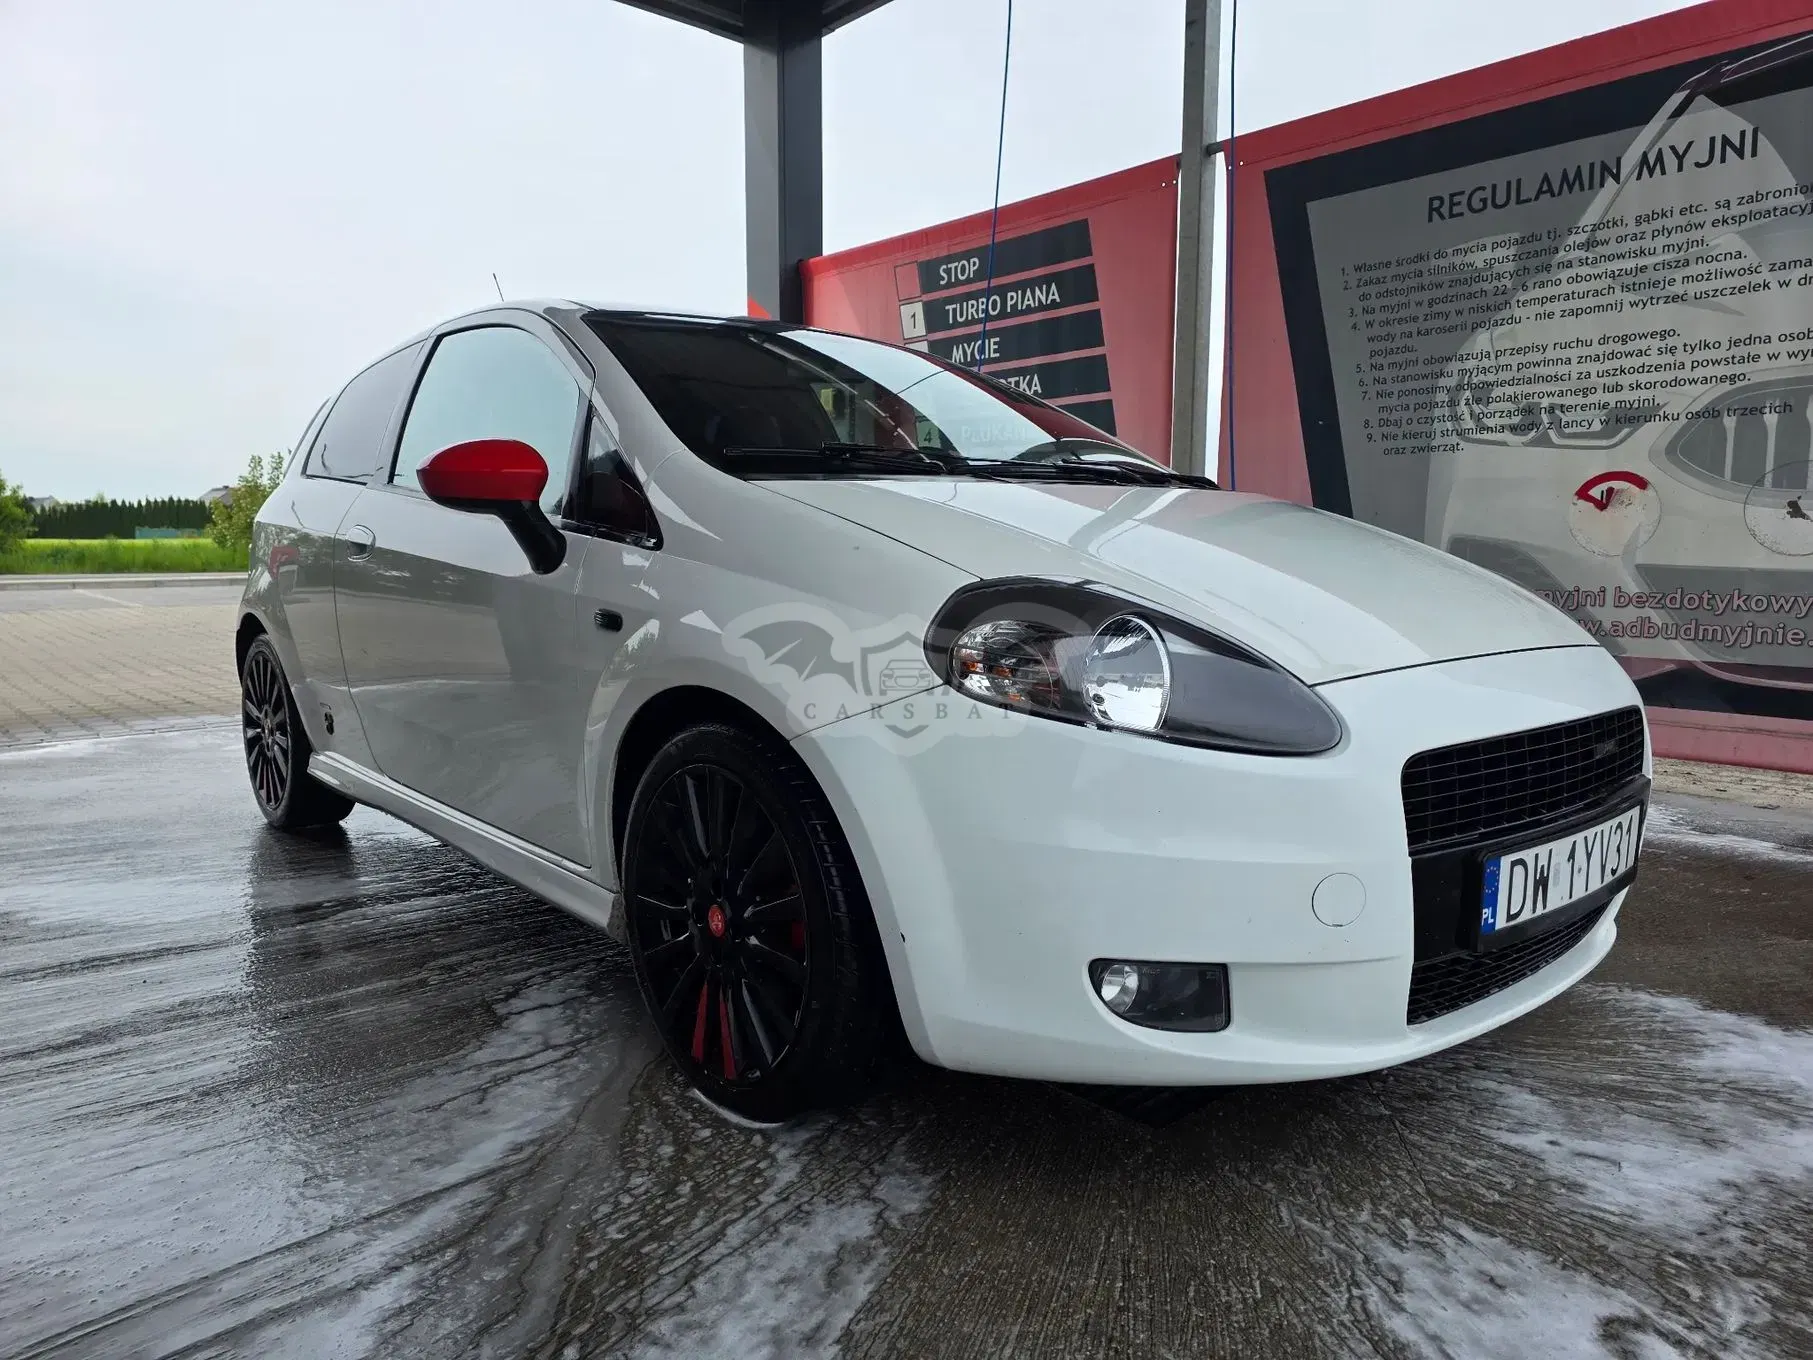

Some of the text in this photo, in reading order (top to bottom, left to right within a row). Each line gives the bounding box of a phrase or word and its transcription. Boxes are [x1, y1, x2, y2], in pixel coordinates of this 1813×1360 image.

[1427, 126, 1760, 223] REGULAMIN MYJNI
[1340, 184, 1813, 276] 1. Własne środki do mycia pojazdu tj. szczotki, gąbki etc. są zabronio
[939, 258, 980, 285] STOP
[1343, 281, 1351, 291] 2.
[1356, 275, 1387, 288] Zakaz
[1391, 268, 1423, 283] mycia
[1427, 259, 1478, 276] silników,
[1483, 244, 1558, 268] spuszczania
[1564, 236, 1611, 253] olejów
[1615, 231, 1646, 244] oraz
[1651, 220, 1706, 241] płynów
[1359, 235, 1710, 301] do odstojników znajdujących się na stanowisku myjni.
[945, 282, 1060, 324] TURBO PIANA
[1349, 308, 1358, 318] 3.
[1362, 304, 1376, 315] Na
[1379, 298, 1410, 314] myjni
[1414, 298, 1423, 307] w
[1427, 286, 1488, 308] godzinach
[1492, 284, 1508, 296] 22
[1521, 281, 1528, 292] 6
[1532, 278, 1562, 290] rano
[1566, 264, 1648, 285] obowiązuje
[1652, 259, 1690, 273] cisza
[1695, 252, 1747, 267] nocna.
[1351, 258, 1812, 333] 4. W okresie zimy w niskich temperaturach istnieje możliwość zama
[909, 312, 917, 330] 1
[1366, 330, 1396, 344] wody
[1400, 330, 1413, 339] na
[1416, 320, 1467, 337] karoserii
[1471, 313, 1522, 332] pojazdu
[1534, 309, 1555, 321] nie
[1559, 298, 1623, 318] zapomnij
[1628, 289, 1688, 310] wytrzeć
[1694, 277, 1771, 299] uszczelek
[1777, 278, 1792, 288] w
[951, 338, 1000, 364] MYCIE
[1356, 329, 1680, 374] 5. Na myjni obowiązują przepisy ruchu drogowego.
[1359, 378, 1368, 388] 6.
[1372, 375, 1387, 386] Na
[1391, 368, 1453, 384] stanowisku
[1458, 364, 1512, 379] myjącym
[1517, 357, 1572, 374] powinna
[1576, 345, 1652, 366] znajdować
[1657, 344, 1678, 358] się
[1682, 338, 1722, 356] tylko
[1726, 334, 1772, 352] jedna
[1369, 344, 1418, 362] pojazdu.
[1361, 391, 1370, 401] 7.
[1376, 387, 1394, 399] Nie
[1398, 383, 1450, 400] ponosimy
[1456, 369, 1572, 393] odpowiedzialności
[1576, 370, 1592, 380] za
[1596, 359, 1686, 378] uszkodzenia
[1690, 351, 1761, 372] powstałe
[1766, 352, 1780, 361] w
[1378, 373, 1750, 416] mycia pojazdu źle polakierowanego lub skorodowanego.
[1364, 395, 1660, 430] 8. Dbaj o czystość i porządek na terenie myjni.
[1366, 399, 1792, 443] 9. Nie kieruj strumienia wody z lancy w kierunku osób trzecich
[923, 427, 932, 444] 4
[1383, 440, 1464, 456] oraz zwierząt.
[1613, 586, 1813, 618] bezdotykowy
[1506, 814, 1634, 923] DW 1YV31
[1482, 906, 1494, 926] PL
